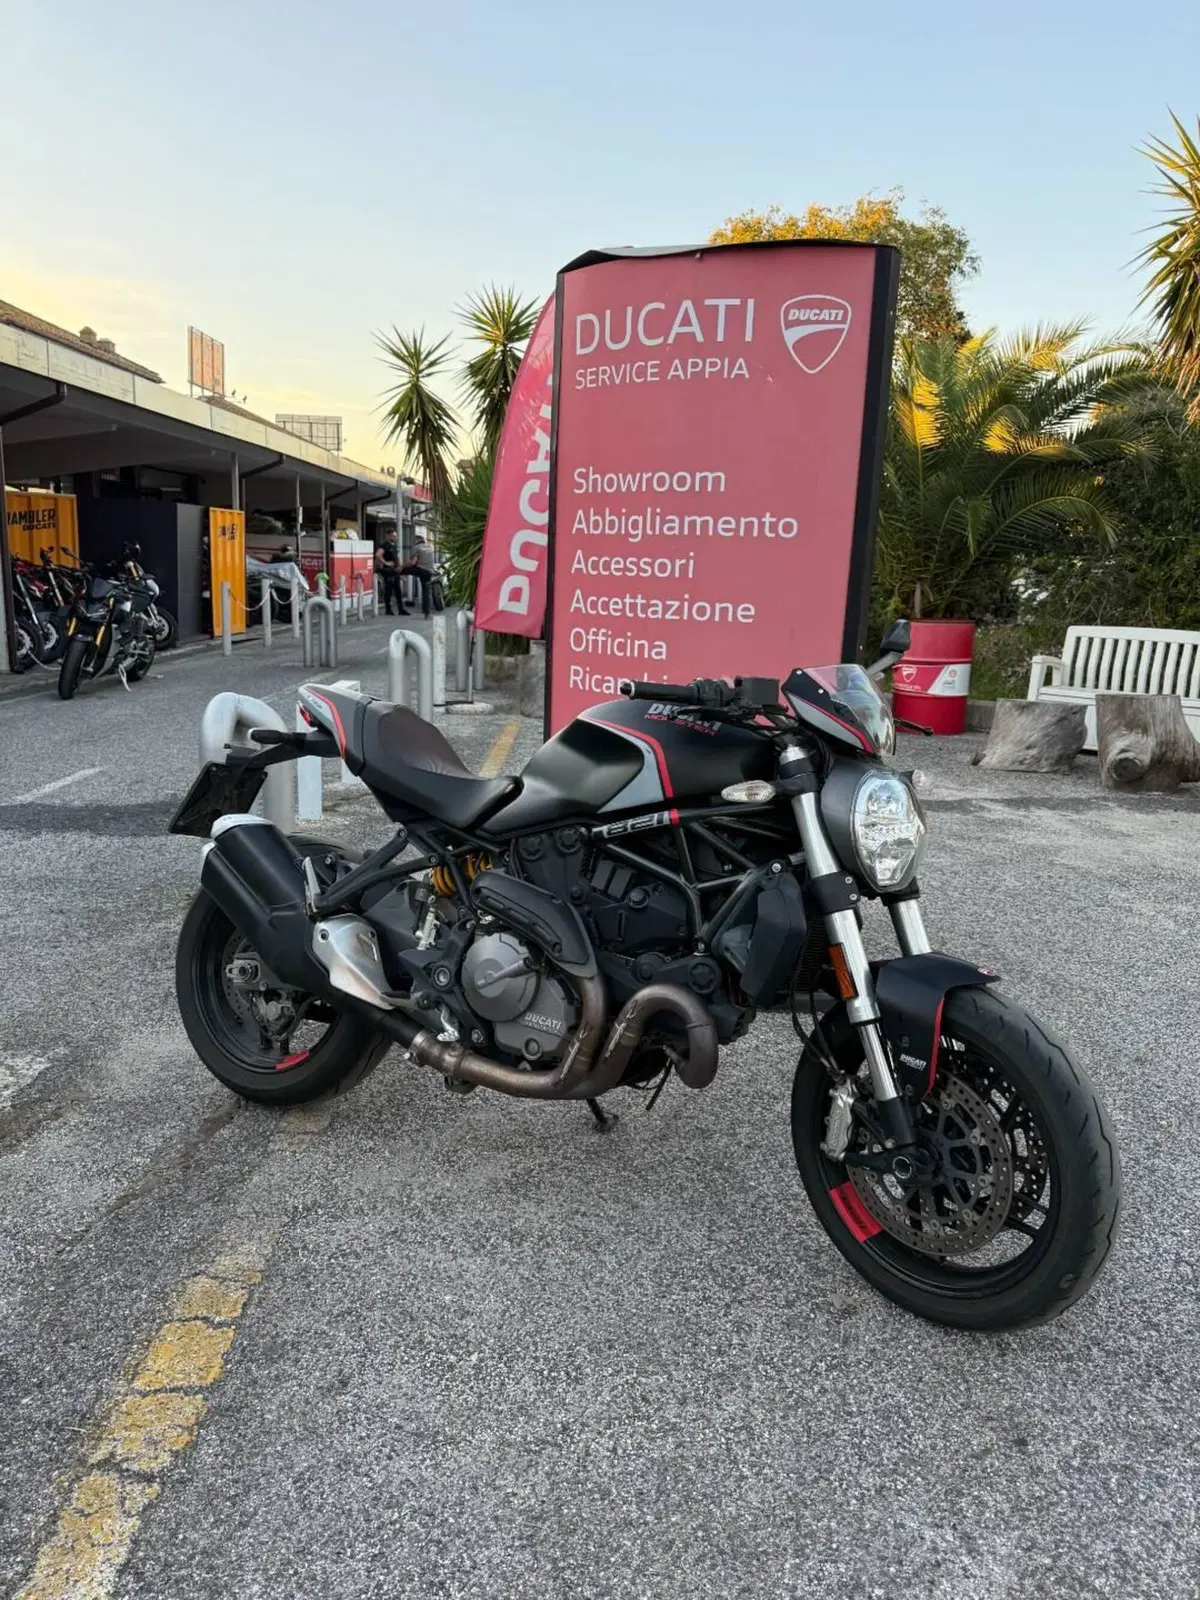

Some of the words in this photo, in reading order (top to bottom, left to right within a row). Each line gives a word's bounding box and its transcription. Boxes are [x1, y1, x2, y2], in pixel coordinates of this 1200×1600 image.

[575, 297, 755, 356] DUCATI
[788, 309, 843, 321] DUCATI
[575, 360, 661, 390] SERVICE
[667, 357, 750, 380] APPIA
[573, 466, 726, 494] Showroom
[7, 508, 56, 525] AMBLER
[571, 507, 799, 543] Abbigliamento
[571, 549, 695, 579] Accessori
[570, 588, 756, 623] Accettazione
[569, 627, 668, 660] Officina
[524, 1012, 562, 1030] DUCATI
[899, 1053, 927, 1068] DUCATI
